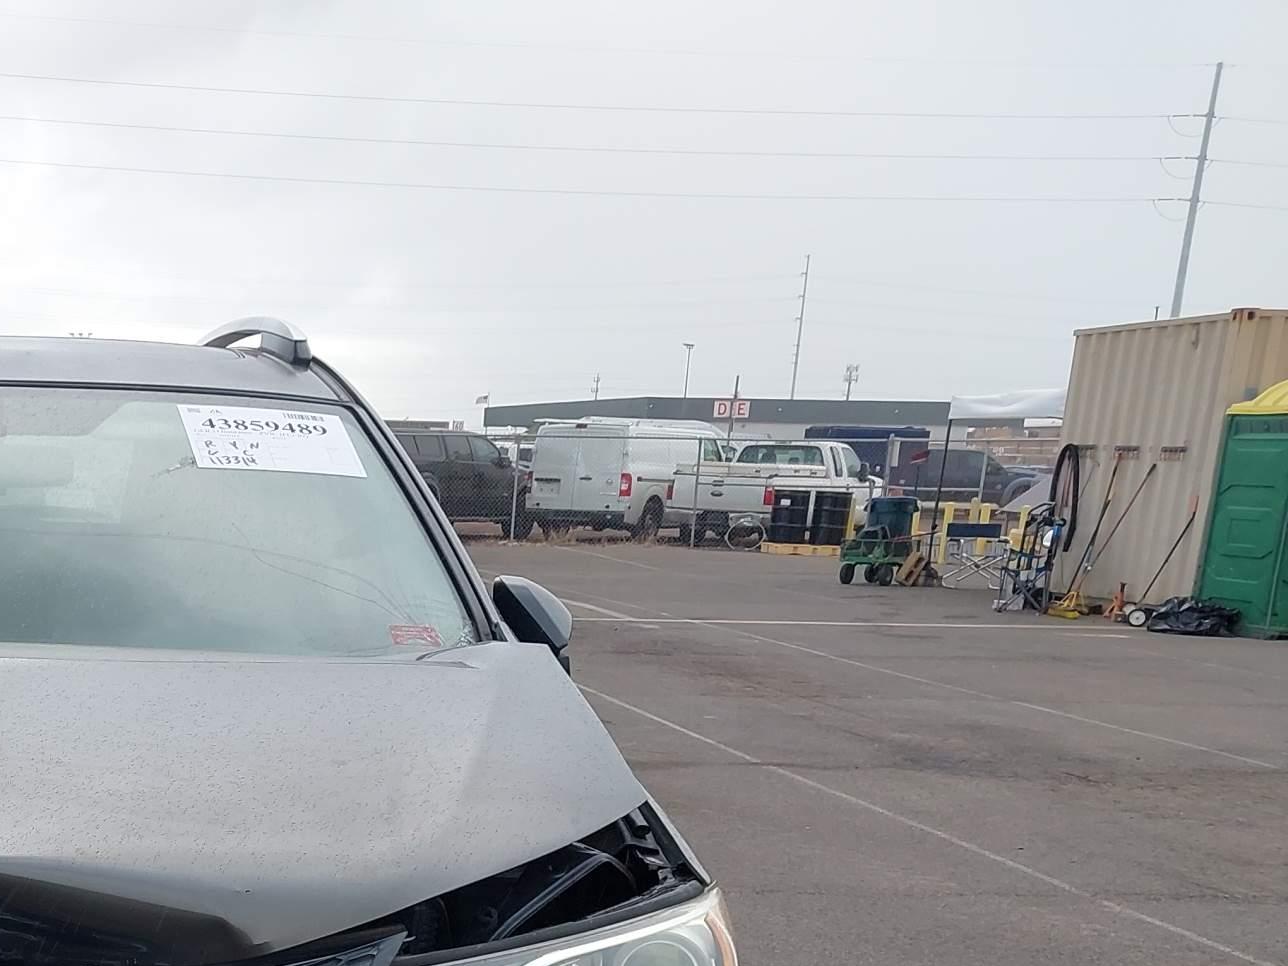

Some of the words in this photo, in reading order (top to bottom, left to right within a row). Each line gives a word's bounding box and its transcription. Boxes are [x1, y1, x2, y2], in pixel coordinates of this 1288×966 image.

[717, 402, 728, 416] D
[737, 402, 747, 416] E
[201, 417, 328, 436] 43859489
